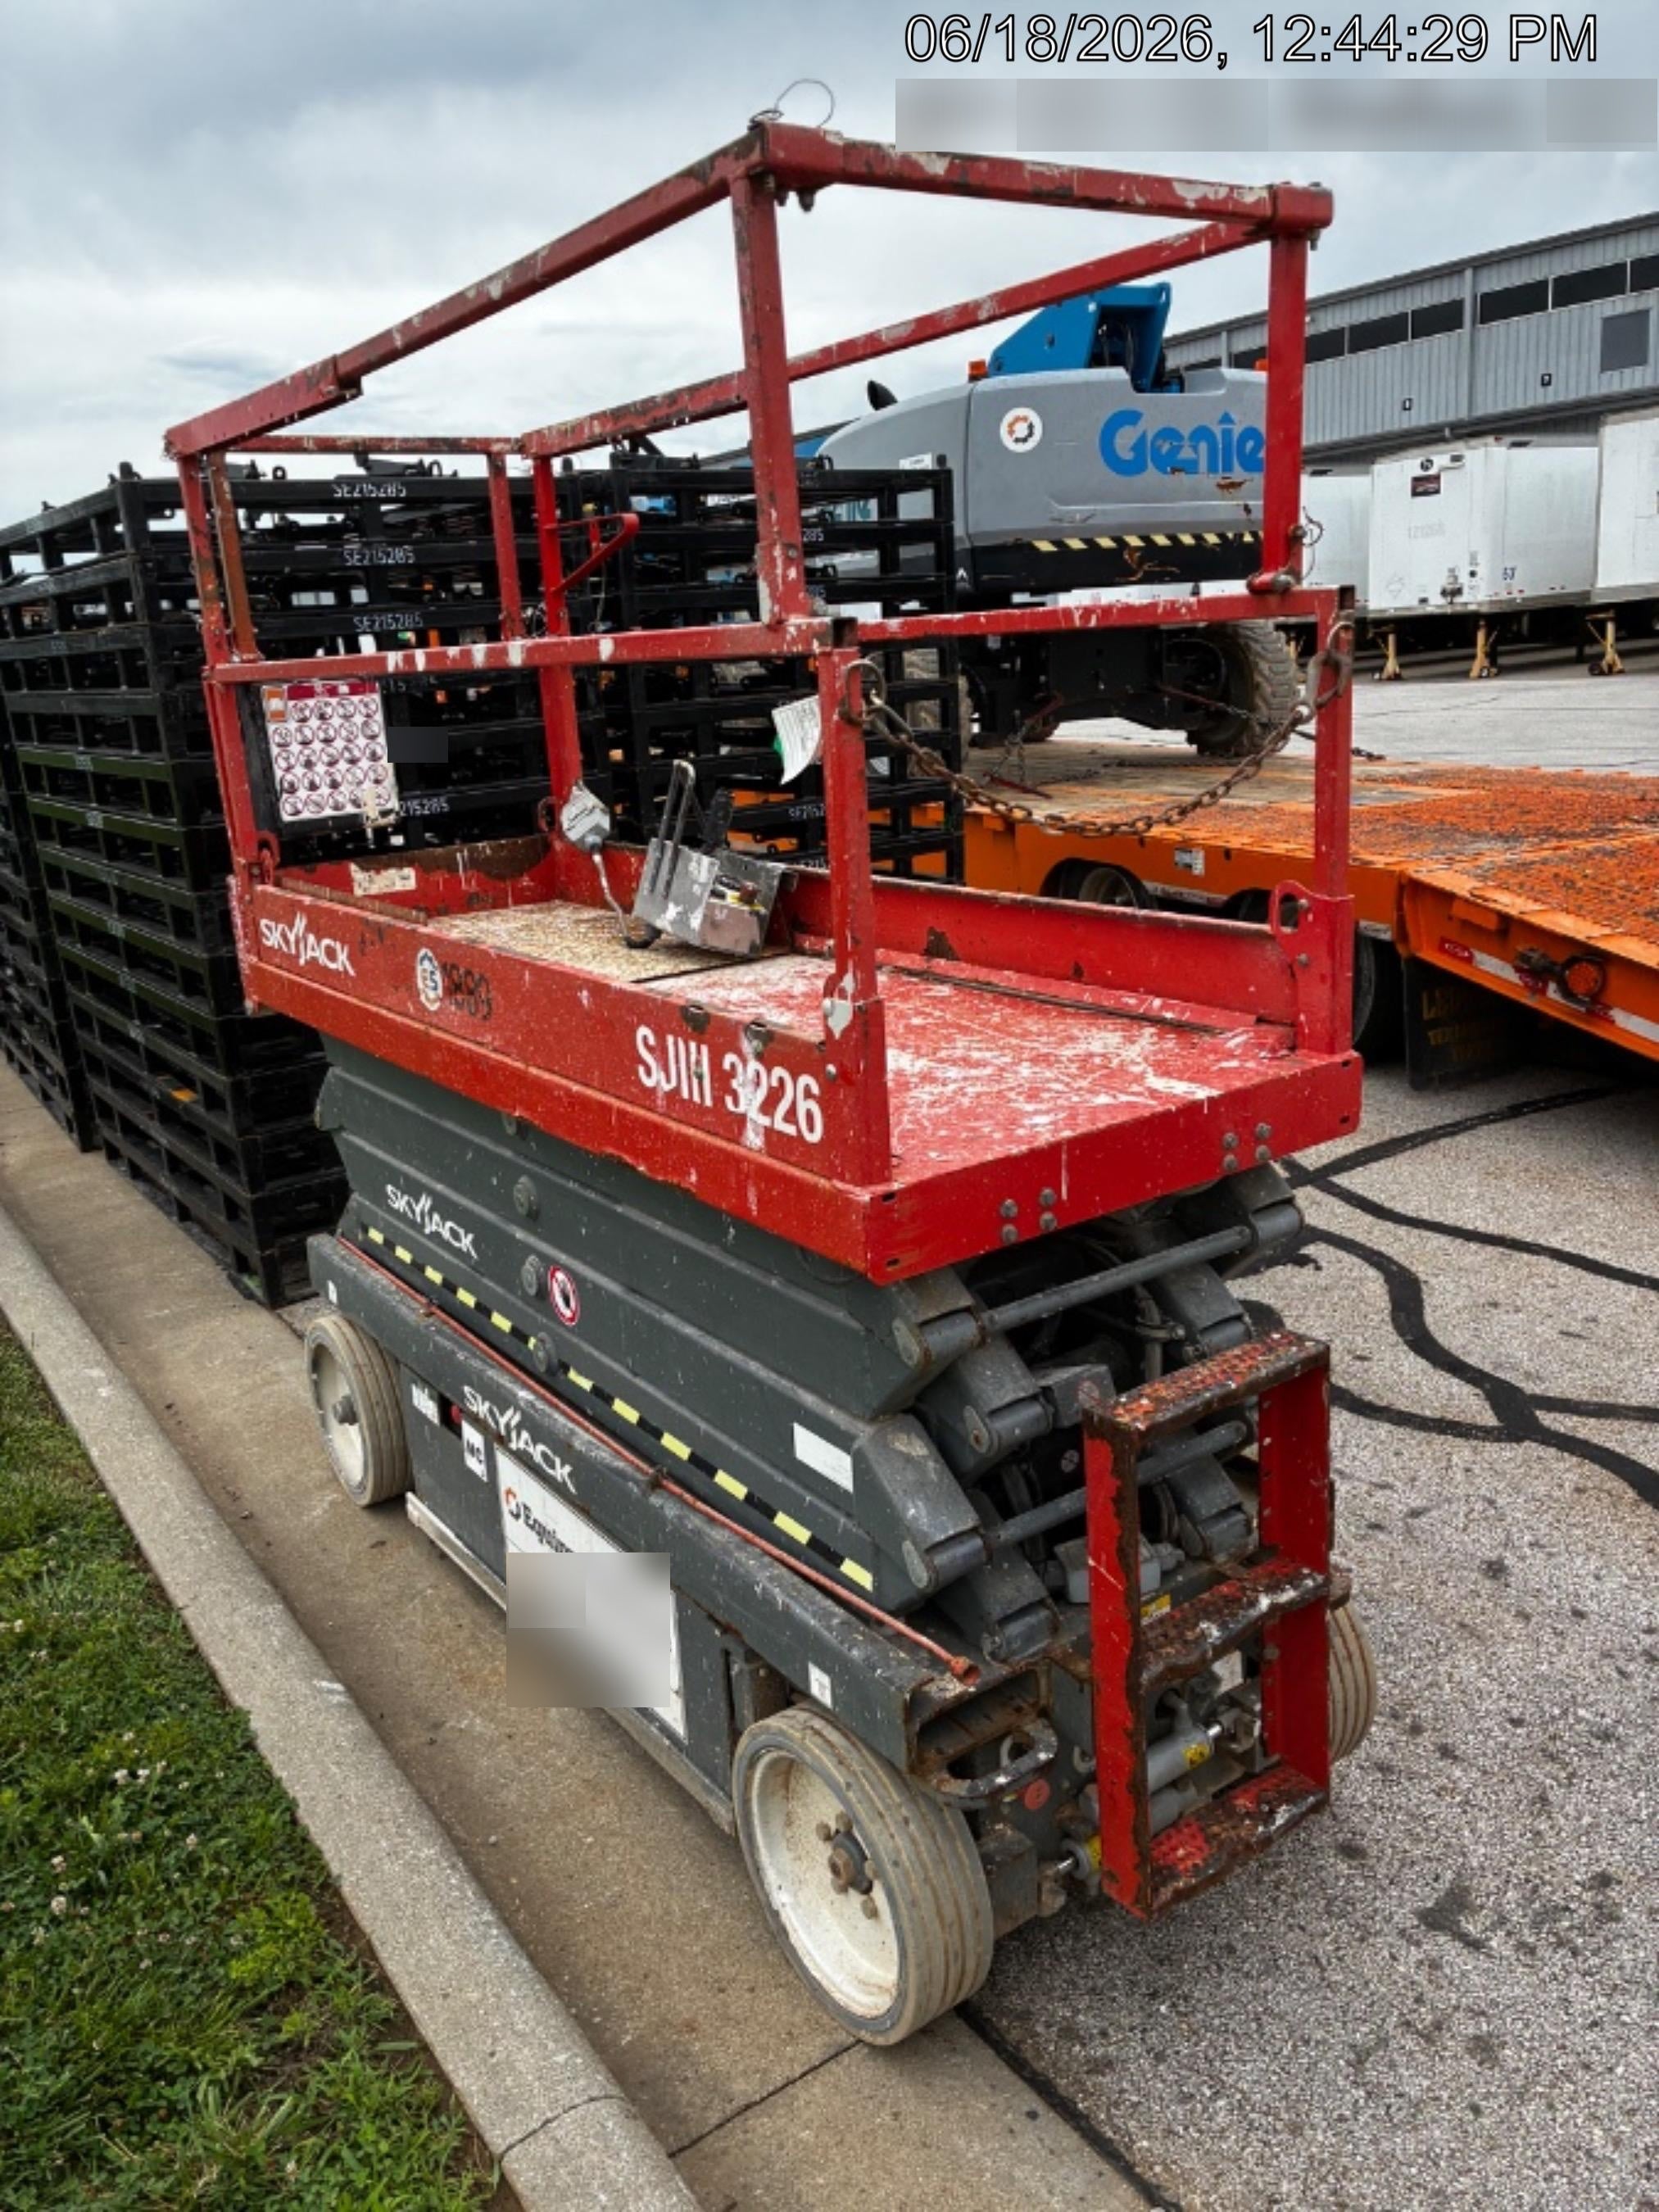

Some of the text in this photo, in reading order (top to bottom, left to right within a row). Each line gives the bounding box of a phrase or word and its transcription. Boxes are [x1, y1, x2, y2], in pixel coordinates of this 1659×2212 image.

[1098, 407, 1265, 478] Genie
[259, 911, 356, 977] SKYJACK
[722, 1052, 824, 1145] 3226
[386, 1184, 478, 1260] SKYJACK
[463, 1385, 578, 1495] SKYJACK
